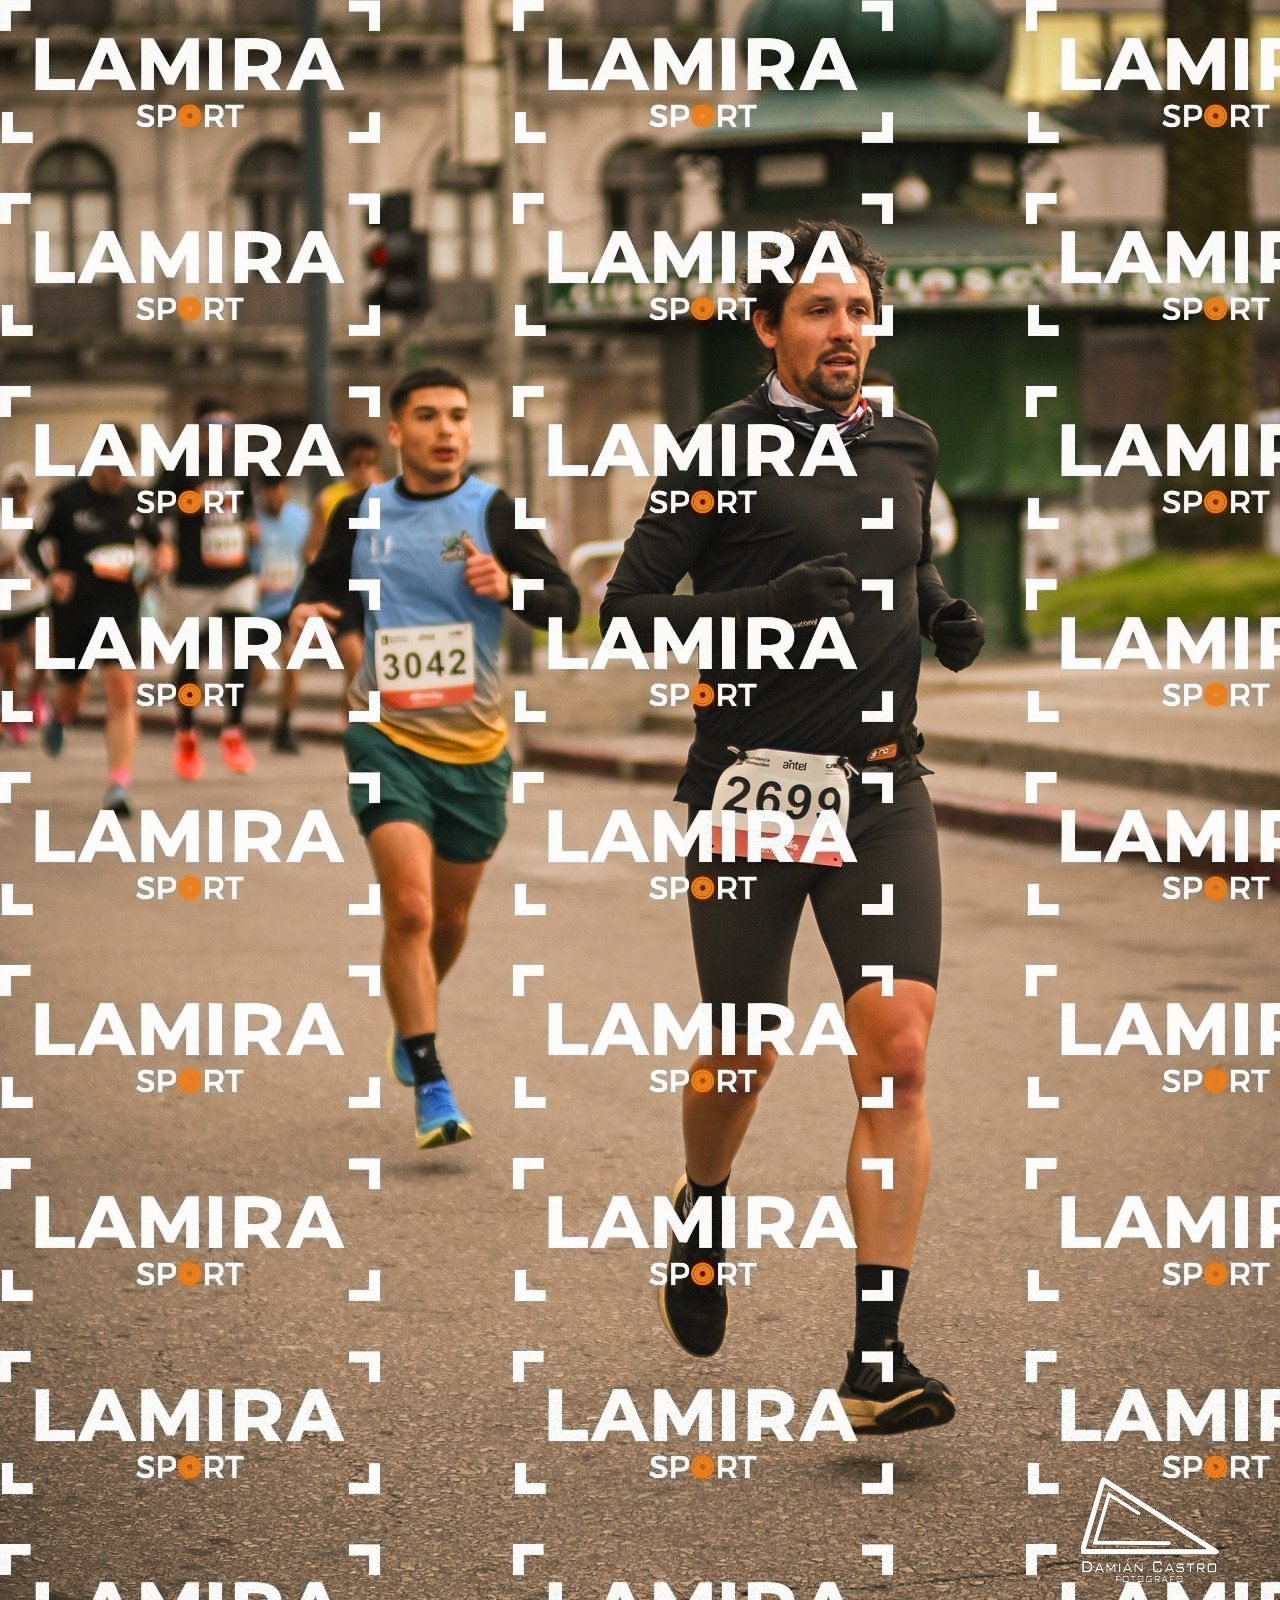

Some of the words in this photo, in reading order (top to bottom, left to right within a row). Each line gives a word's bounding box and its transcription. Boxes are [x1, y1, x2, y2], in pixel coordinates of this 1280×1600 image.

[790, 618, 818, 629] aucony
[382, 648, 466, 681] 3042
[782, 759, 808, 772] antel
[722, 775, 842, 820] 2699
